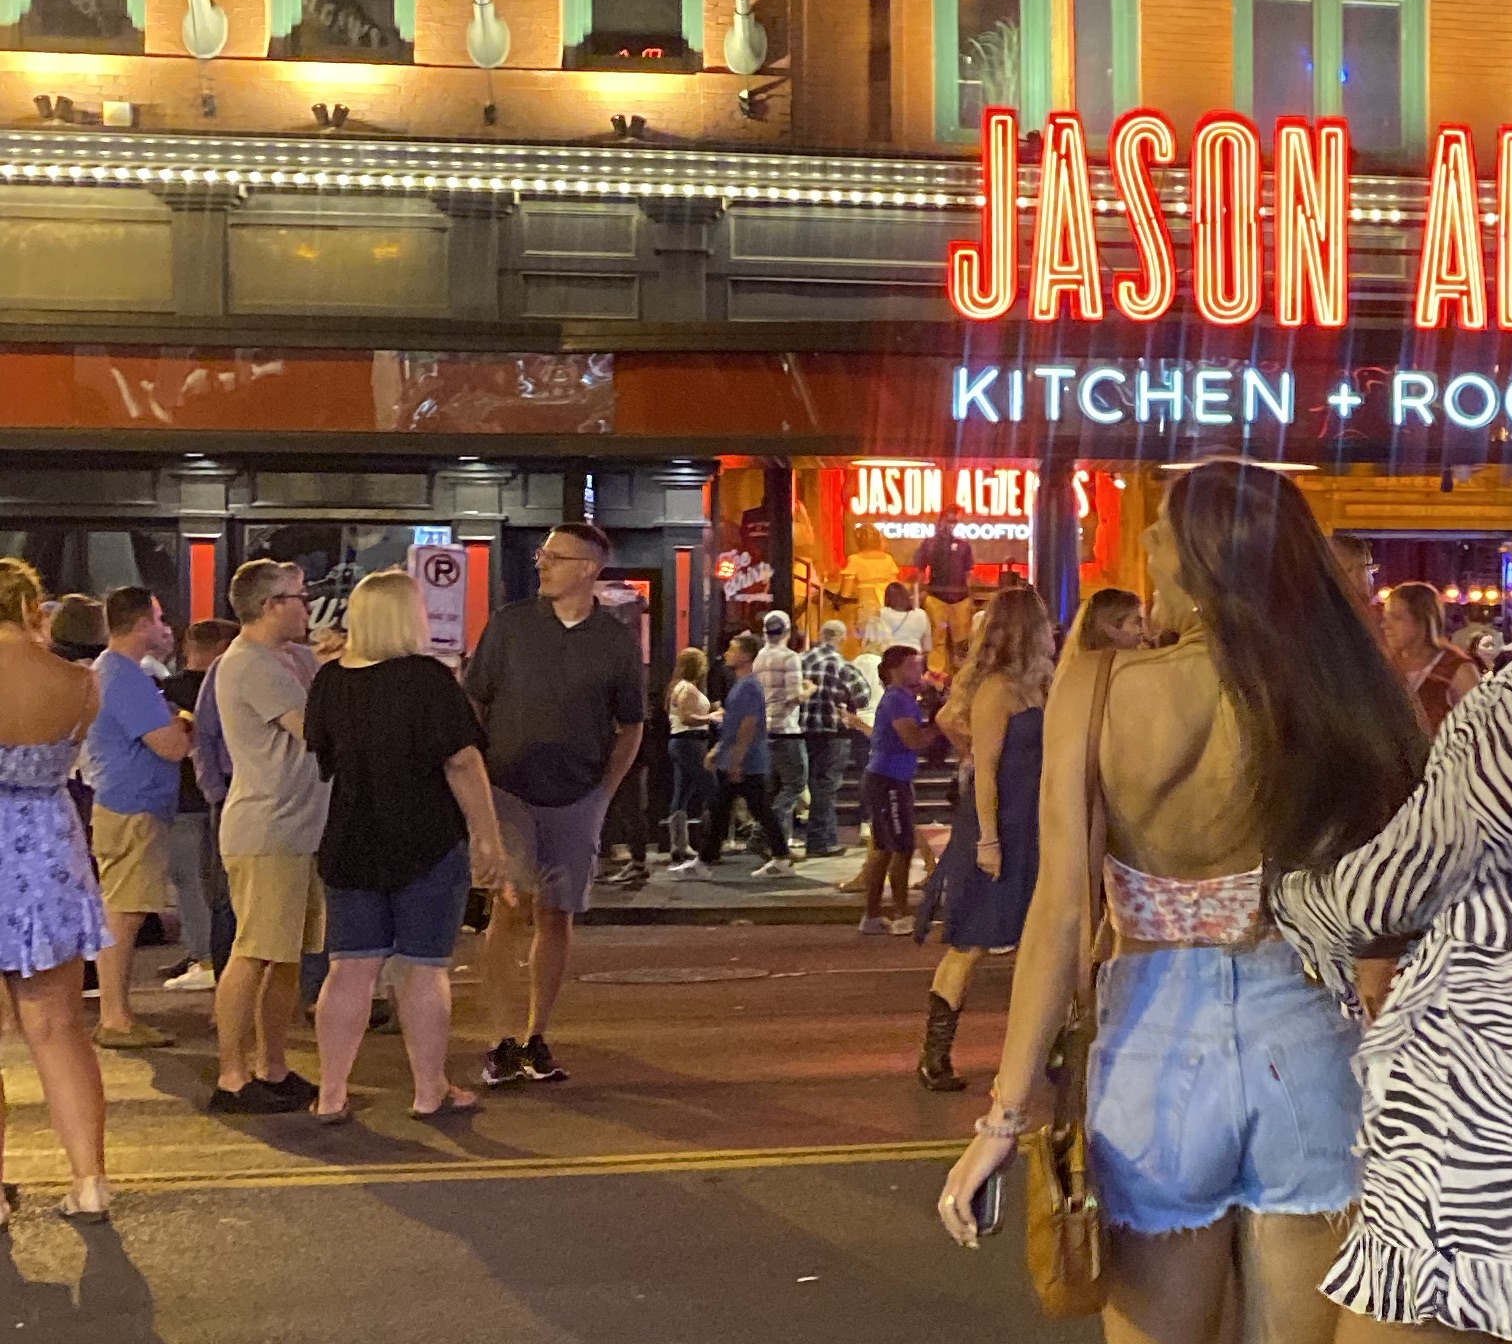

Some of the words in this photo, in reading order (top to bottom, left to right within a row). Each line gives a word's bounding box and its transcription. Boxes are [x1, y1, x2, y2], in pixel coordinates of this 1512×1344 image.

[947, 107, 1351, 330] JASON
[952, 365, 1295, 425] KITCHEN
[851, 467, 942, 516] JASON
[956, 468, 1089, 518] ALDES
[952, 523, 1031, 540] ROOFTO
